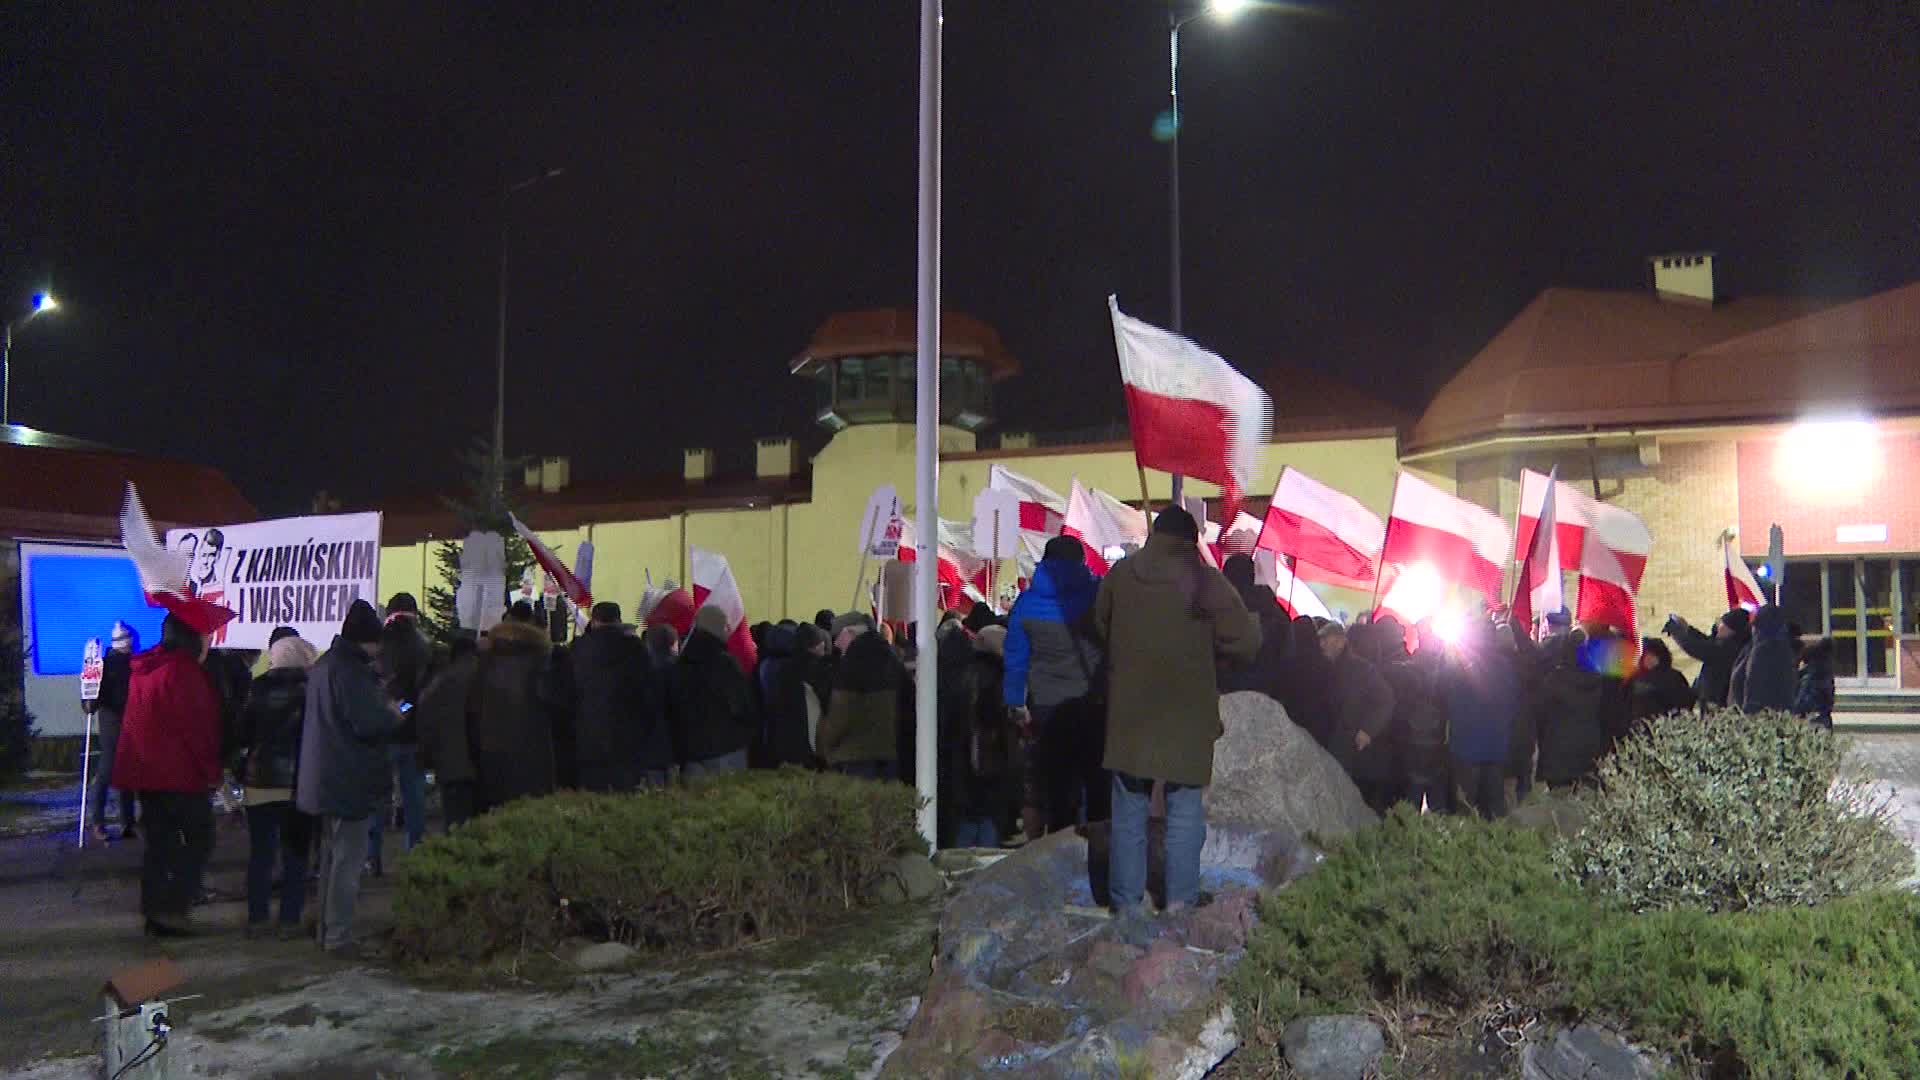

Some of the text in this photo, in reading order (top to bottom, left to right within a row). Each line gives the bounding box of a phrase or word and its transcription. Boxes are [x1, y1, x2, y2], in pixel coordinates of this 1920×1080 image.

[232, 538, 376, 583] Z KAMIŃSKIM
[238, 588, 245, 623] I
